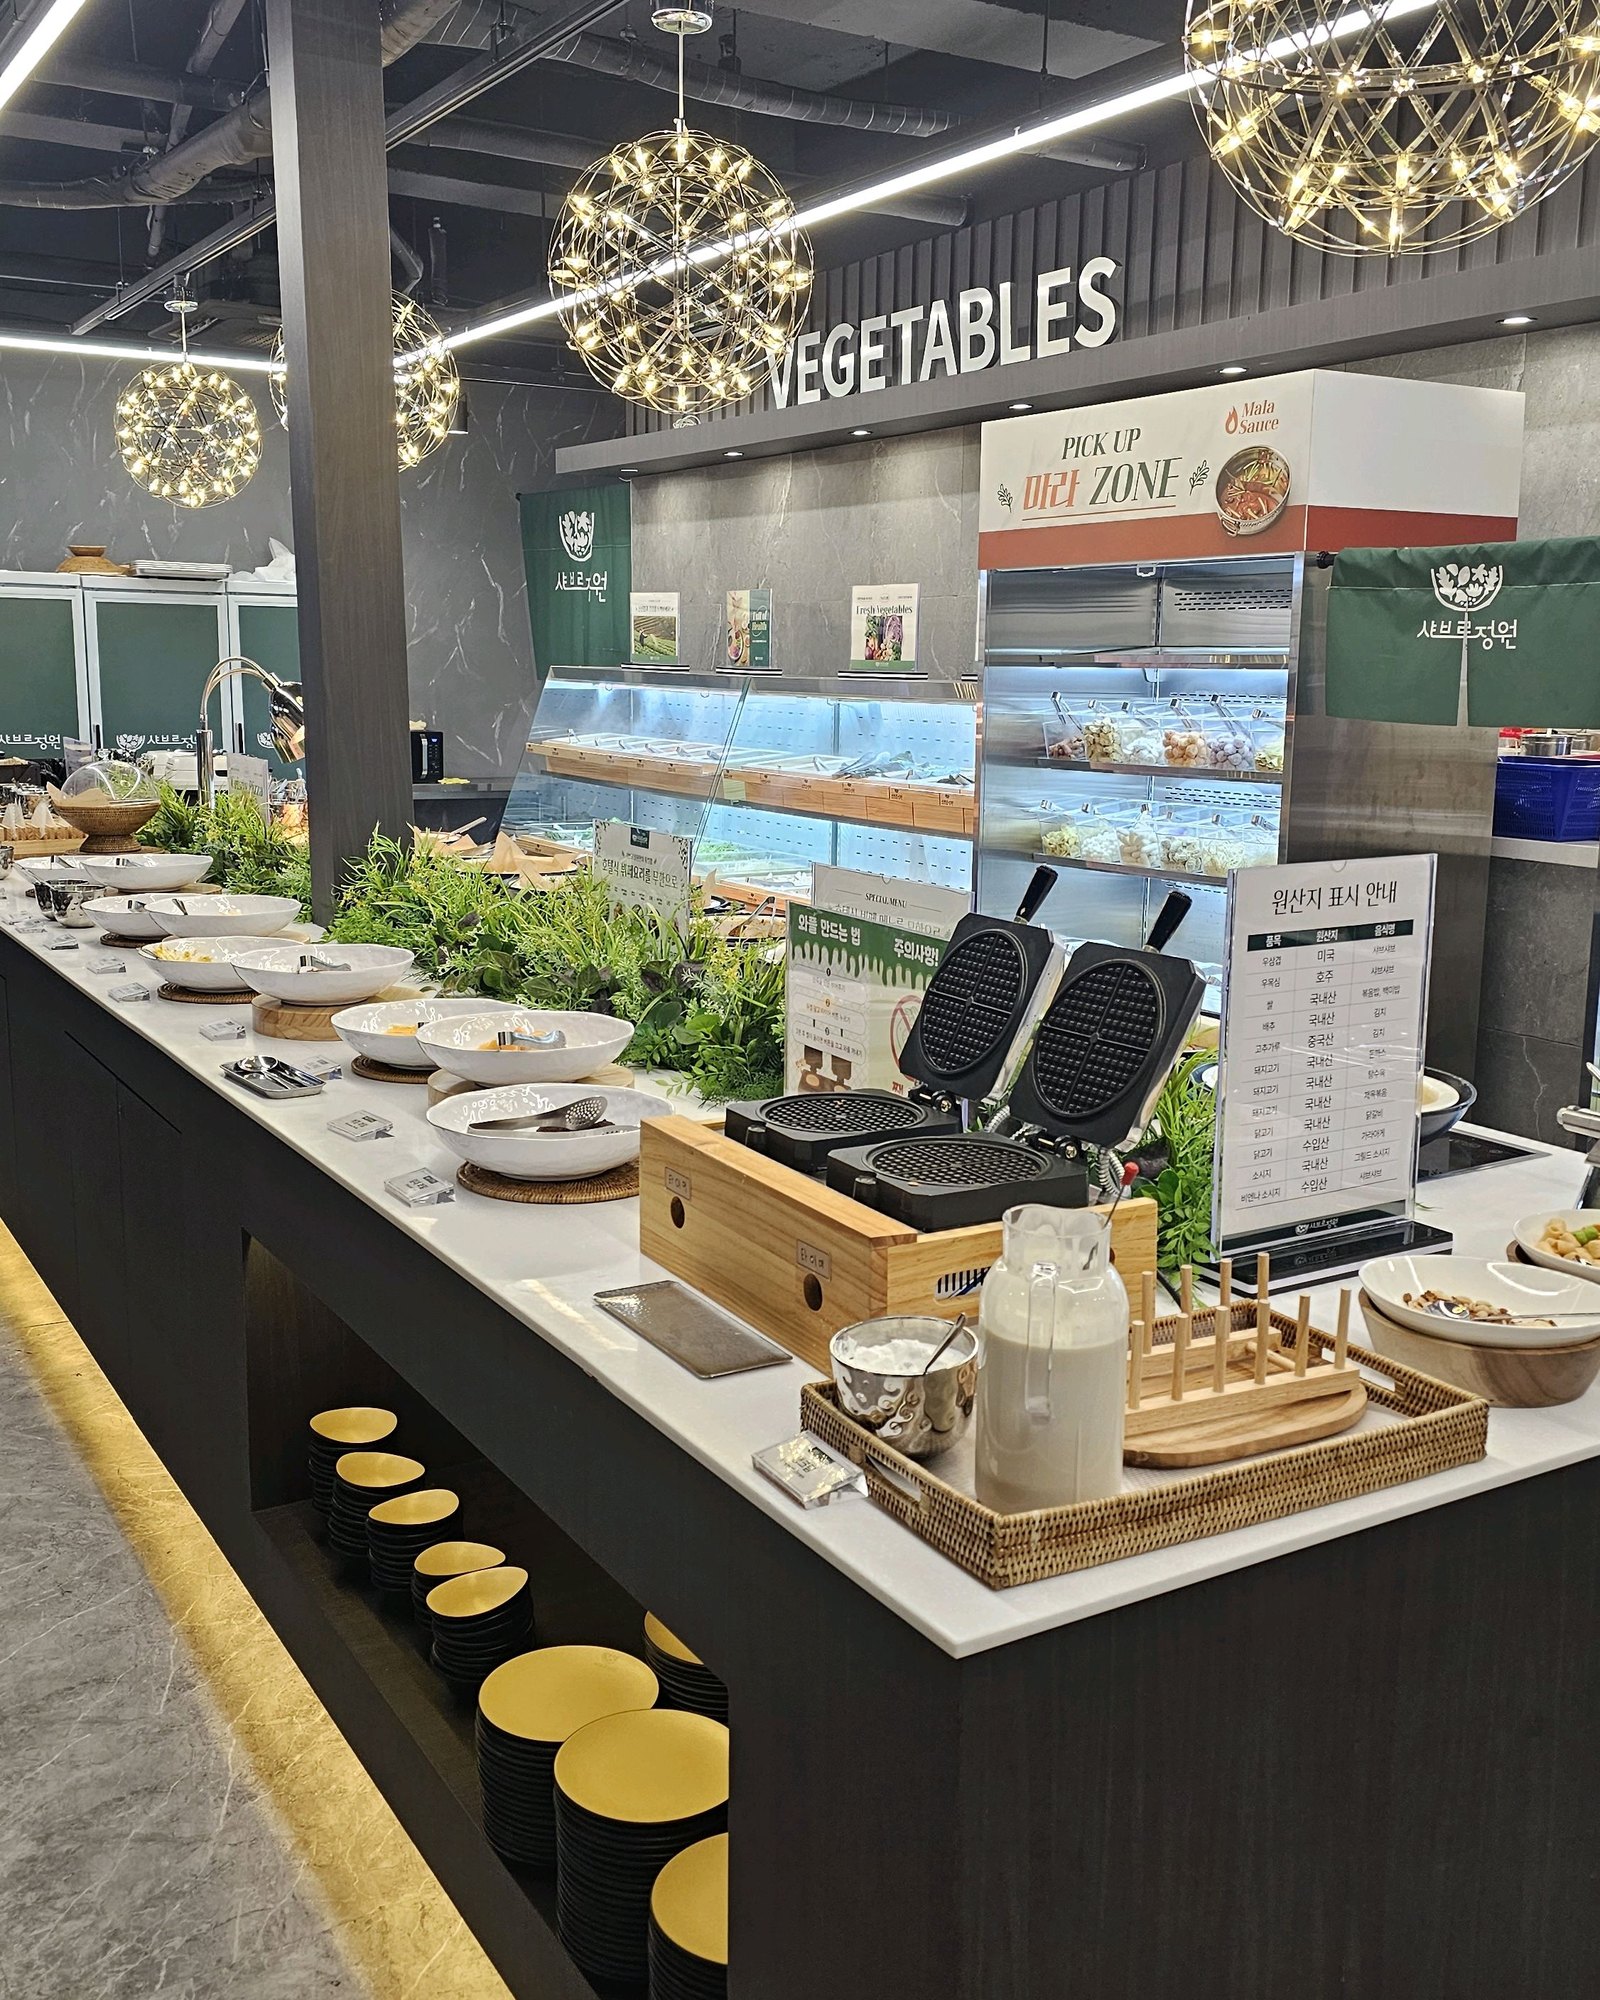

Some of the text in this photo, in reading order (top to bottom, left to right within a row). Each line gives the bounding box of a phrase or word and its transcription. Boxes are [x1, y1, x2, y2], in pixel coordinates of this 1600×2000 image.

[766, 257, 1119, 409] VEGETABLES
[1241, 399, 1275, 417] Mala
[1239, 417, 1279, 434] Sauce
[1062, 427, 1141, 459] PICK UP
[1023, 456, 1182, 511] 마라 ZONE
[856, 604, 913, 615] Fresh Vegetables
[865, 893, 907, 908] SPECIAL MENU
[1271, 881, 1398, 915] 원산지 표시 안내
[798, 914, 861, 946] 와플 만드는 법
[1265, 923, 1396, 948] 품목 원산지 음식명
[893, 938, 940, 967] 주의사항!
[1317, 949, 1335, 962] 미국
[1316, 970, 1334, 984] 호주
[1371, 965, 1395, 975] 샤브샤브
[1310, 991, 1337, 1006] 국내산
[1262, 1007, 1387, 1031] 배추 국내산 김치
[1255, 1028, 1385, 1054] 고추가루 중국산 김치
[1254, 1063, 1280, 1075] 돼지고기
[1307, 1054, 1333, 1069] 국내산
[1253, 1084, 1279, 1096] 돼지고기
[1305, 1074, 1333, 1089] 국내산
[1252, 1105, 1278, 1118] 돼지고기
[1304, 1095, 1332, 1110] 국내산
[1254, 1127, 1274, 1139] 닭고기
[1303, 1115, 1331, 1131] 국내산
[1253, 1148, 1273, 1160] 닭고기
[1302, 1136, 1330, 1152] 수입산
[1252, 1169, 1272, 1181] 소시지
[1302, 1156, 1329, 1173] 국내산
[1372, 1147, 1390, 1158] 소시지
[1261, 1187, 1281, 1200] 소시지
[1301, 1177, 1328, 1193] 수입산
